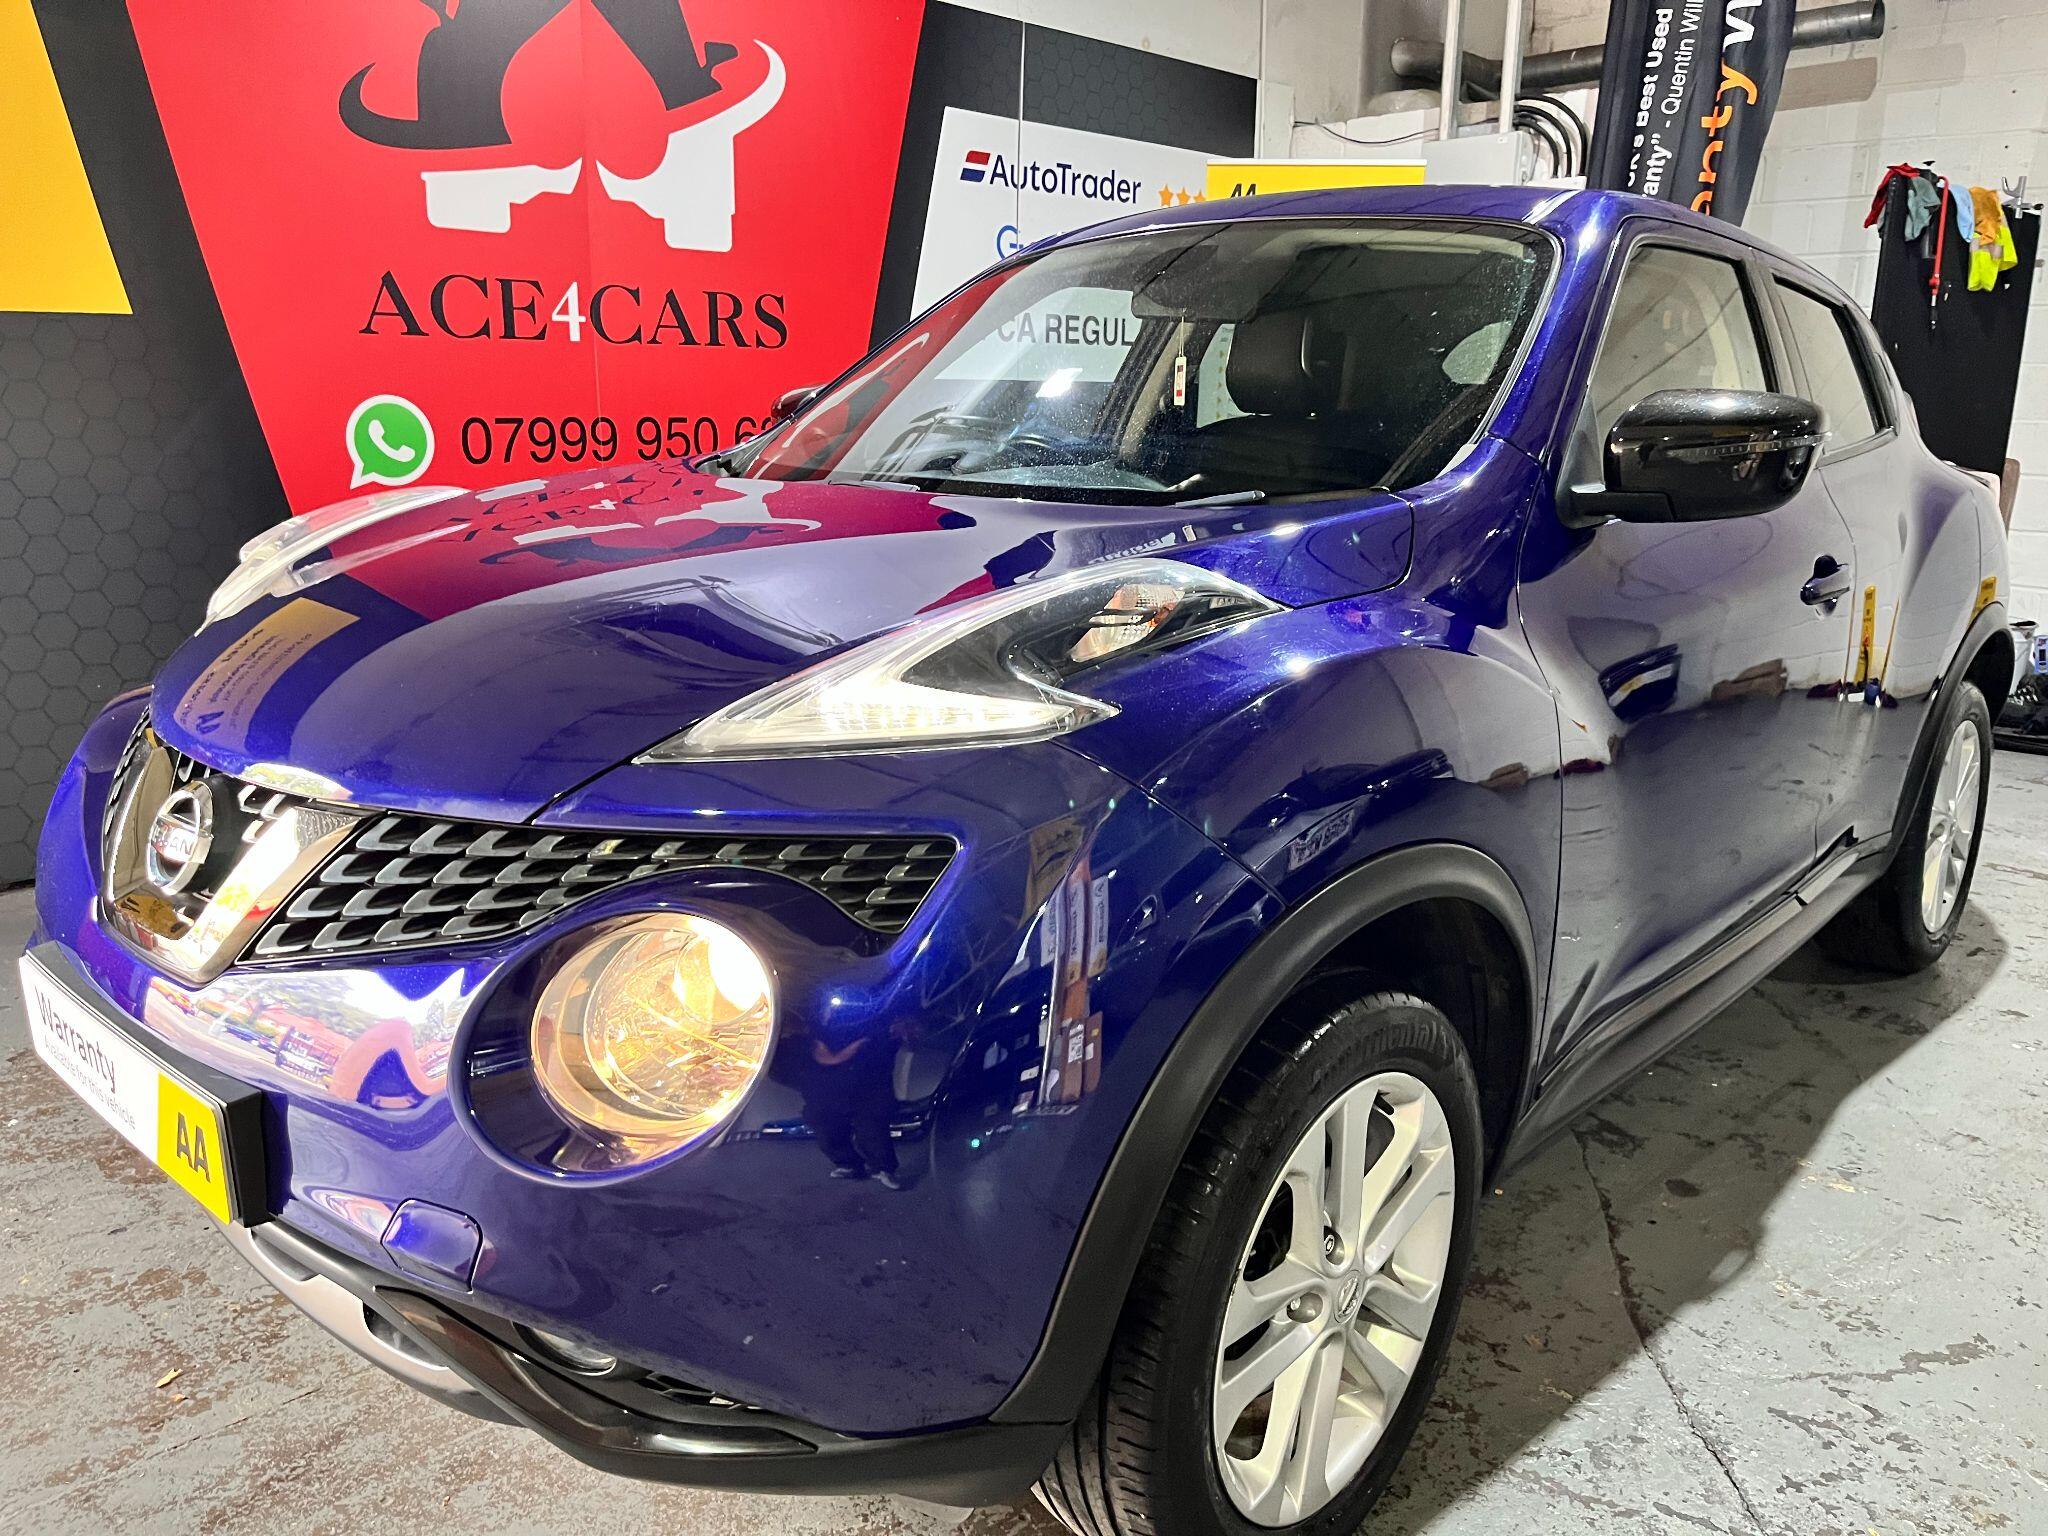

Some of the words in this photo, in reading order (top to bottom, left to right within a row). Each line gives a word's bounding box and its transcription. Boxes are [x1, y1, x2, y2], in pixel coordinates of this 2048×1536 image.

[1645, 8, 1674, 68] Used
[1660, 38, 1696, 115] Quentin
[989, 154, 1142, 205] AutoTrader
[359, 270, 788, 350] ACE4CARS
[461, 416, 618, 465] 07999
[636, 416, 719, 460] 950
[34, 986, 116, 1094] Warranty
[176, 1111, 212, 1184] AA
